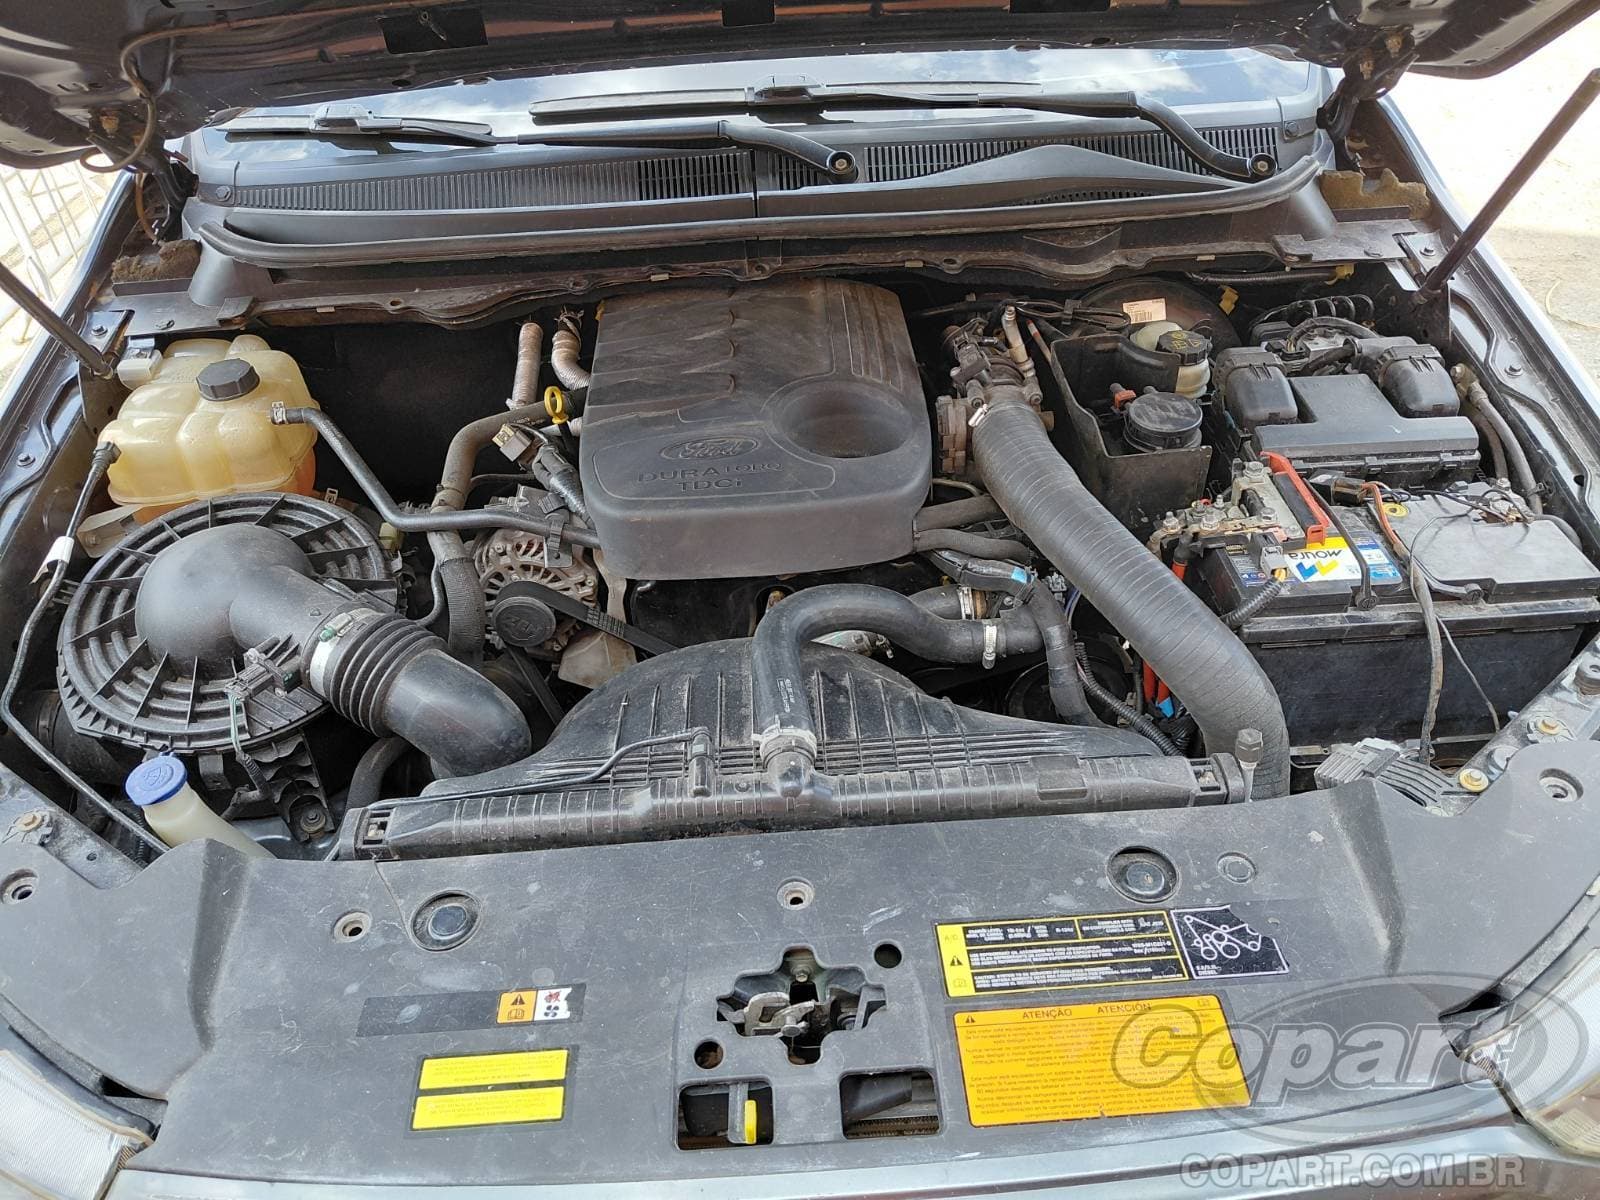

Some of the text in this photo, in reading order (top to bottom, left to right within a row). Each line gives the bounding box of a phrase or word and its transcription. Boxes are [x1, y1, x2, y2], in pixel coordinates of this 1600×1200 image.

[679, 438, 743, 459] Ford
[1023, 1002, 1152, 1020] ATENÇÃO ATENCIÓN
